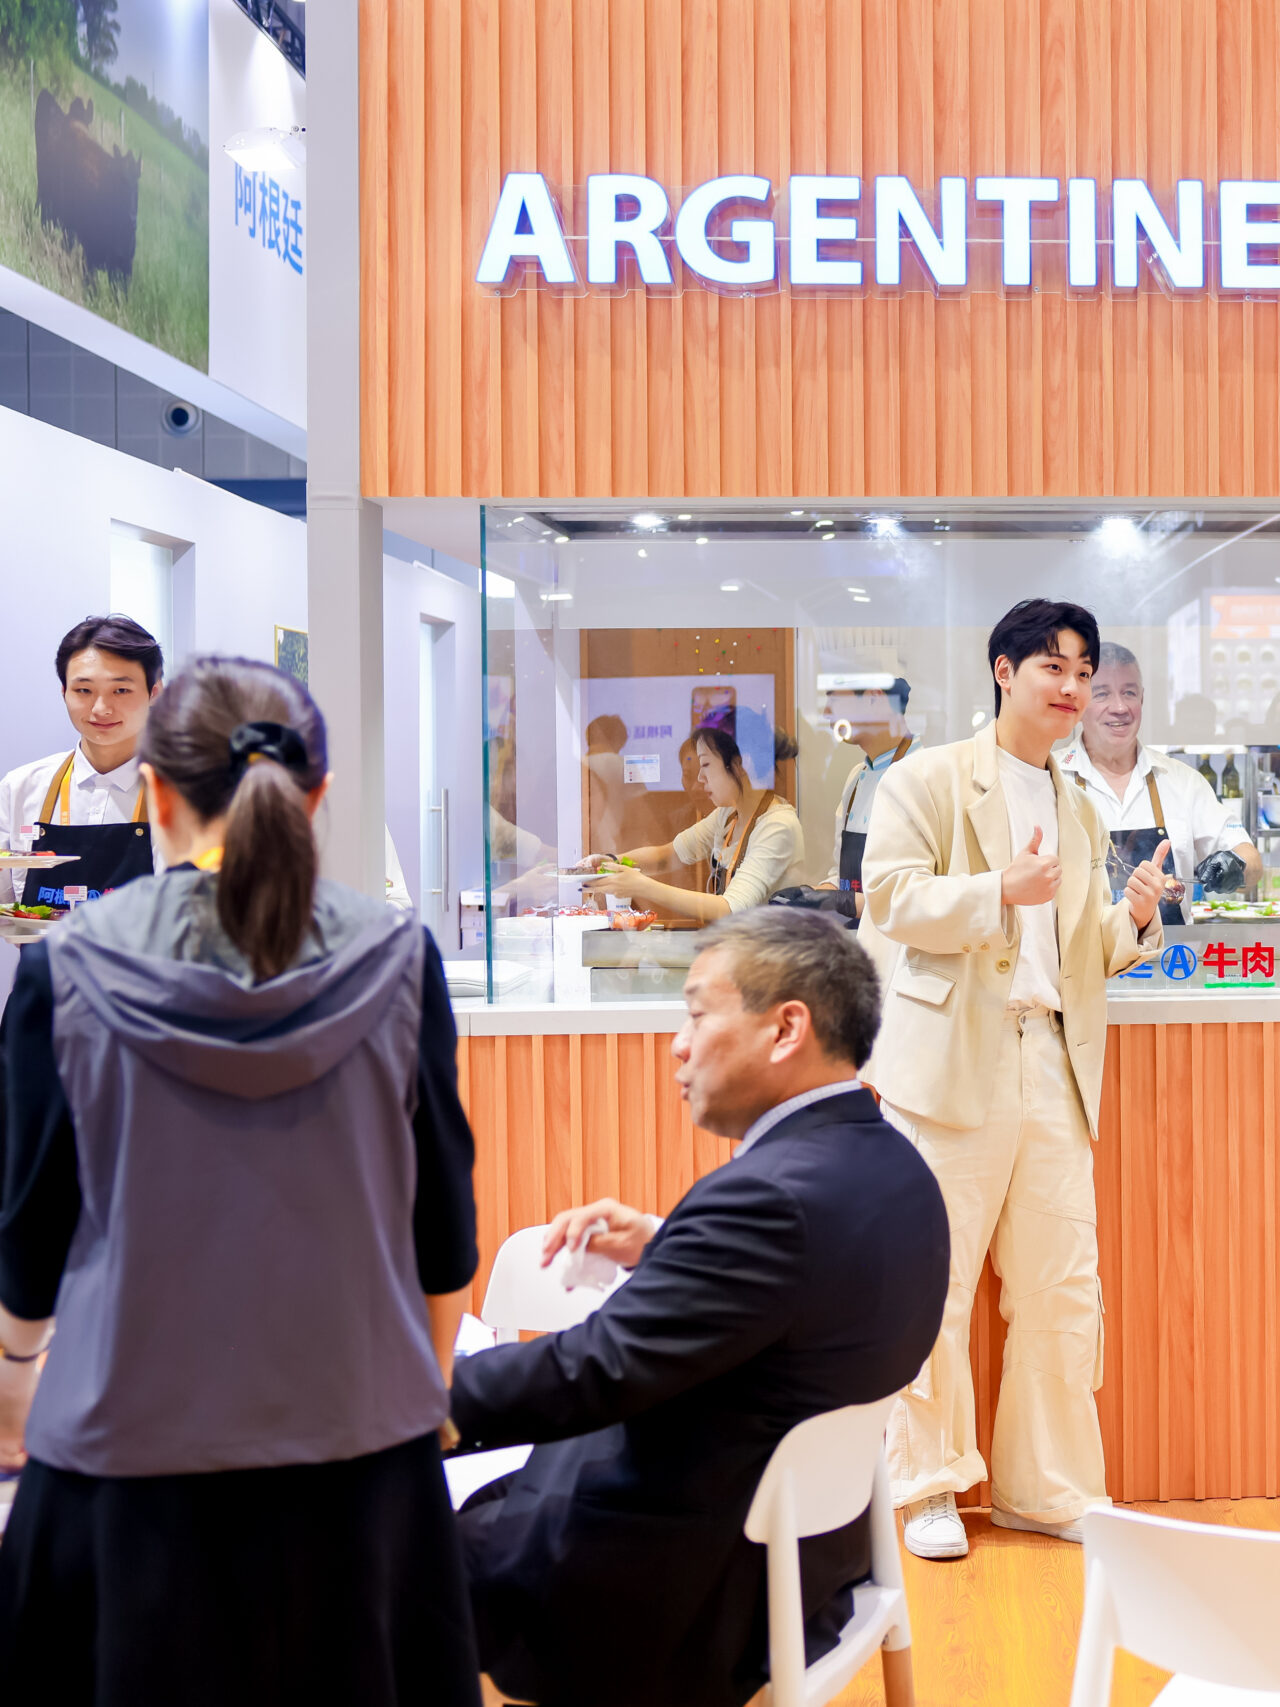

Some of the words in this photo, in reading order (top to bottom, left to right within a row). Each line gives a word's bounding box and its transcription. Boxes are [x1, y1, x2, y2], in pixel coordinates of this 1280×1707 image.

[234, 161, 303, 275] 阿根廷
[1203, 942, 1274, 978] 牛肉
